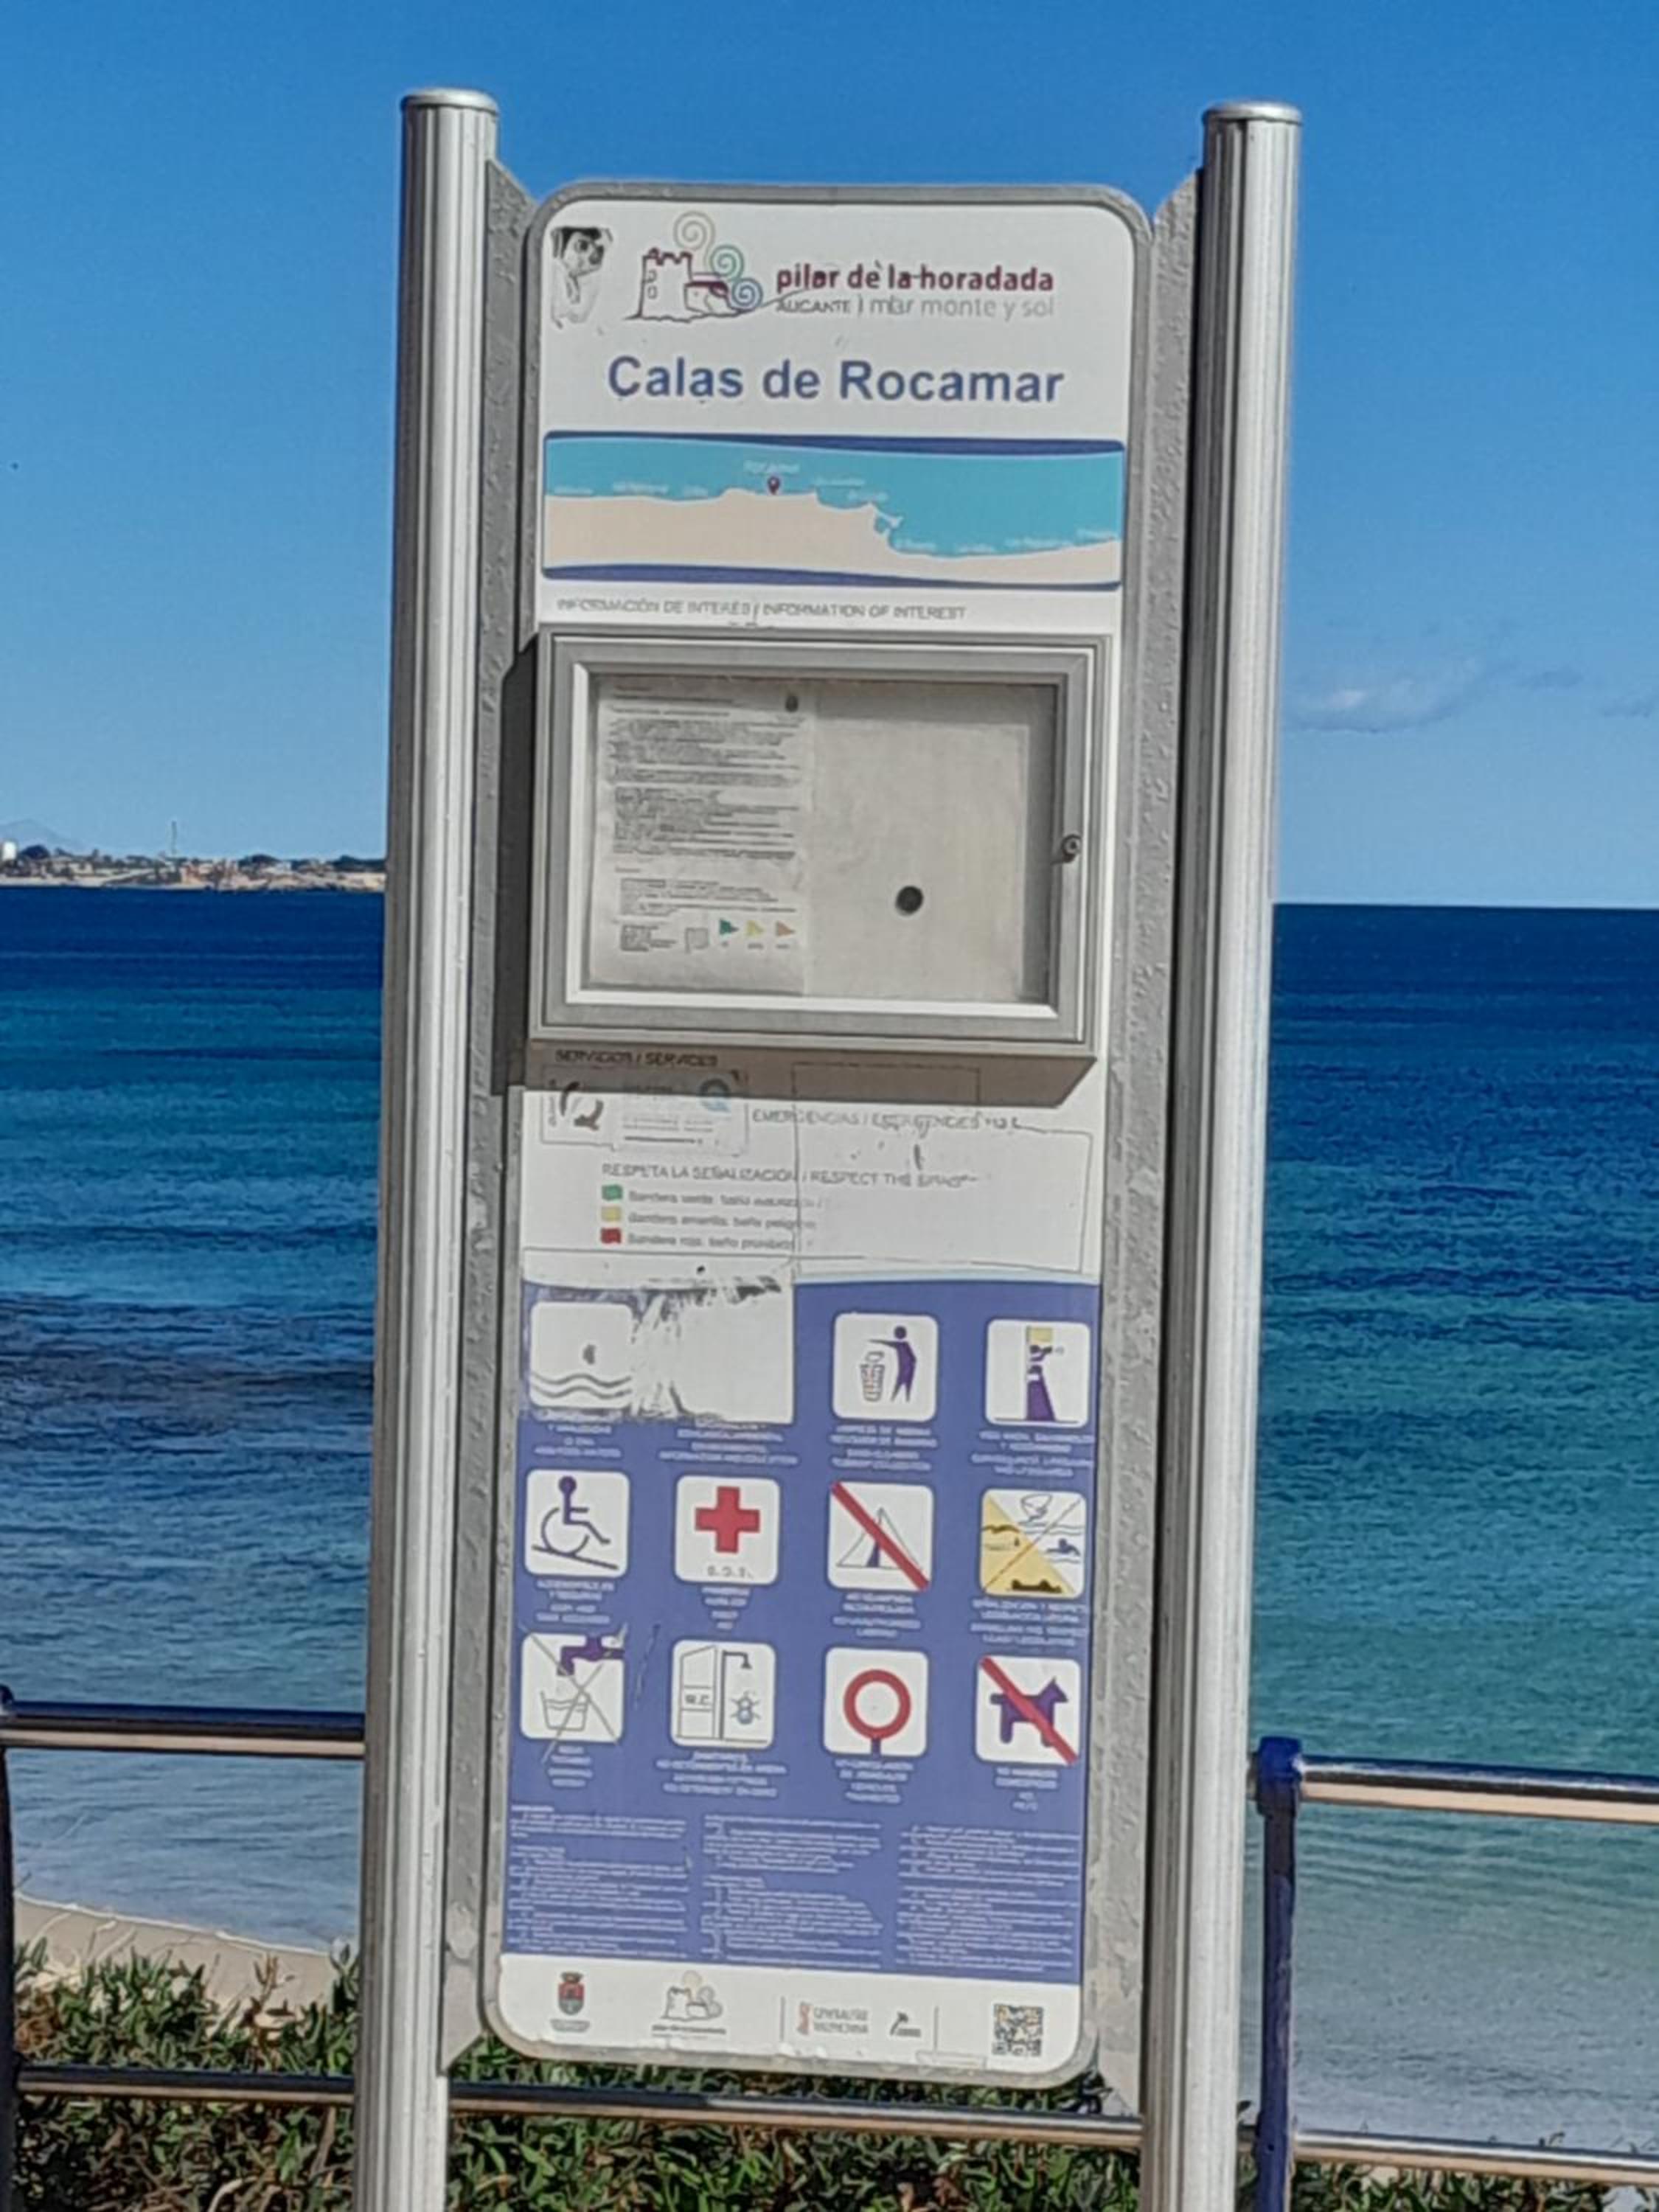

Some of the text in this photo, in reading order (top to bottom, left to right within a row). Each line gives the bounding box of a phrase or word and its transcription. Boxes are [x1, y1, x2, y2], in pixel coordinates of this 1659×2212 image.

[776, 262, 1054, 294] pilar de la horadada
[776, 298, 851, 314] ALICANTE
[869, 296, 914, 316] mar
[921, 297, 996, 317] monte
[1002, 300, 1016, 321] y
[1021, 297, 1054, 318] sol
[608, 355, 1065, 403] Calas de Rocamar
[663, 600, 684, 614] DE
[762, 602, 866, 618] INFORMATION
[869, 604, 888, 618] OF
[893, 605, 967, 620] INTEREST
[601, 1162, 669, 1178] RESPETA
[671, 1164, 690, 1179] LA
